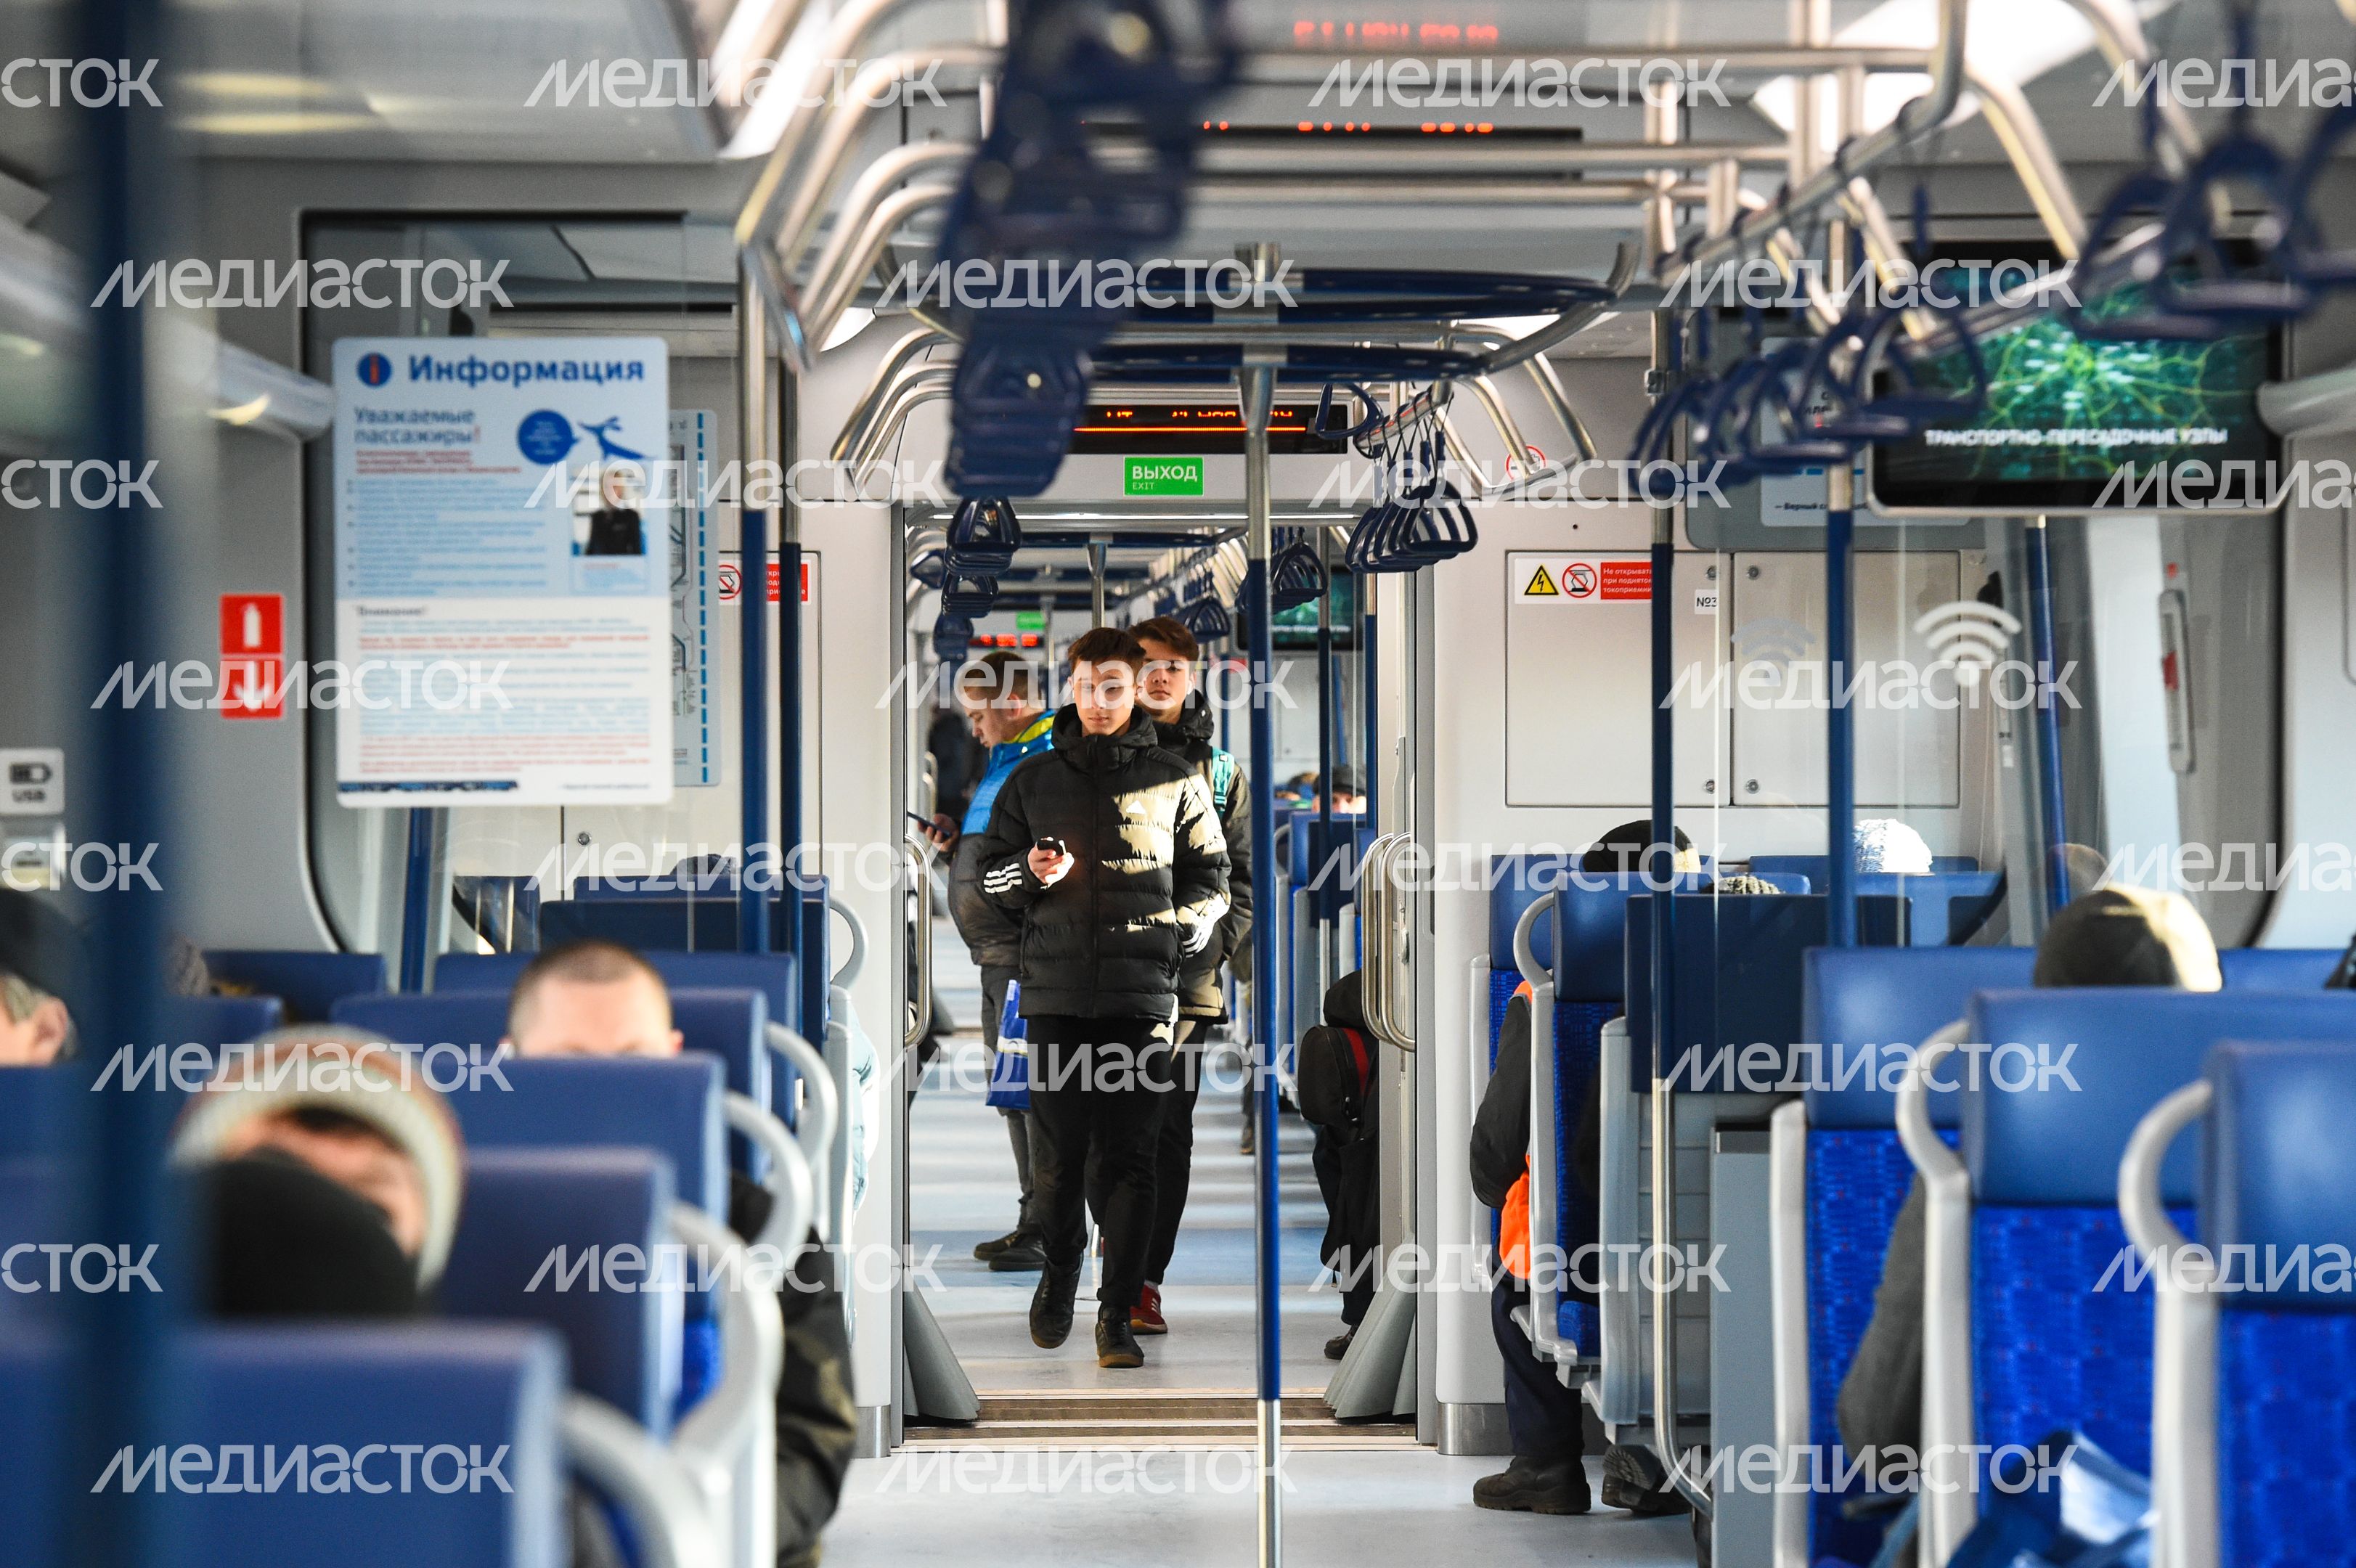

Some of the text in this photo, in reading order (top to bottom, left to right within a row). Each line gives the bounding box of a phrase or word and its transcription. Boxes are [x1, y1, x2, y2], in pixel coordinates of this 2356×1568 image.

[408, 354, 645, 388] Информация
[355, 407, 475, 425] Уважаемые
[354, 427, 480, 445] пассажиры!
[1133, 465, 1197, 482] ВЫХОД
